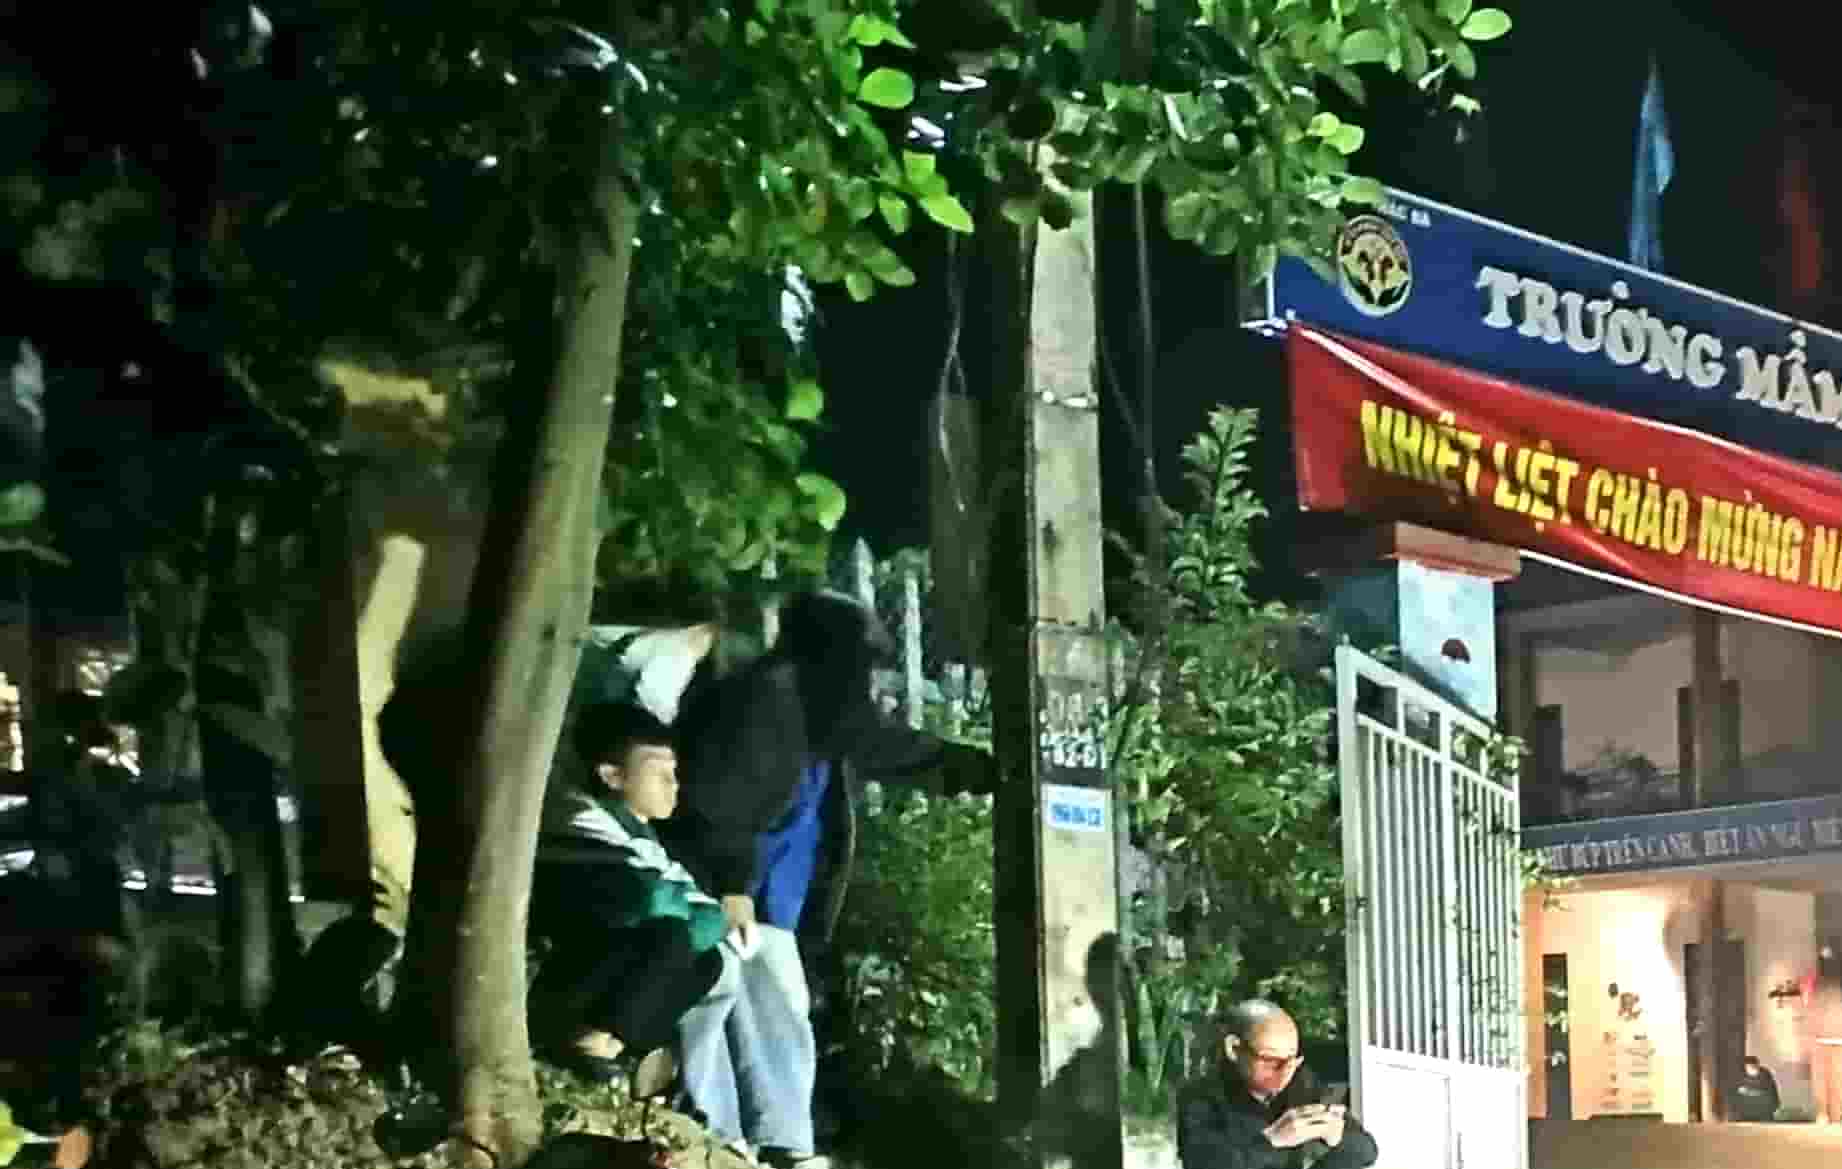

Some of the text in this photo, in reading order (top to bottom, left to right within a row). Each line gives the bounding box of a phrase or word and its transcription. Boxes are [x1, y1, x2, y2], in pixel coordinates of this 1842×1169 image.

[1475, 266, 1727, 389] TRƯỜNG
[1493, 440, 1580, 533] LIỆT
[1585, 467, 1690, 555] CHÀO
[1696, 489, 1805, 583] MỪNG
